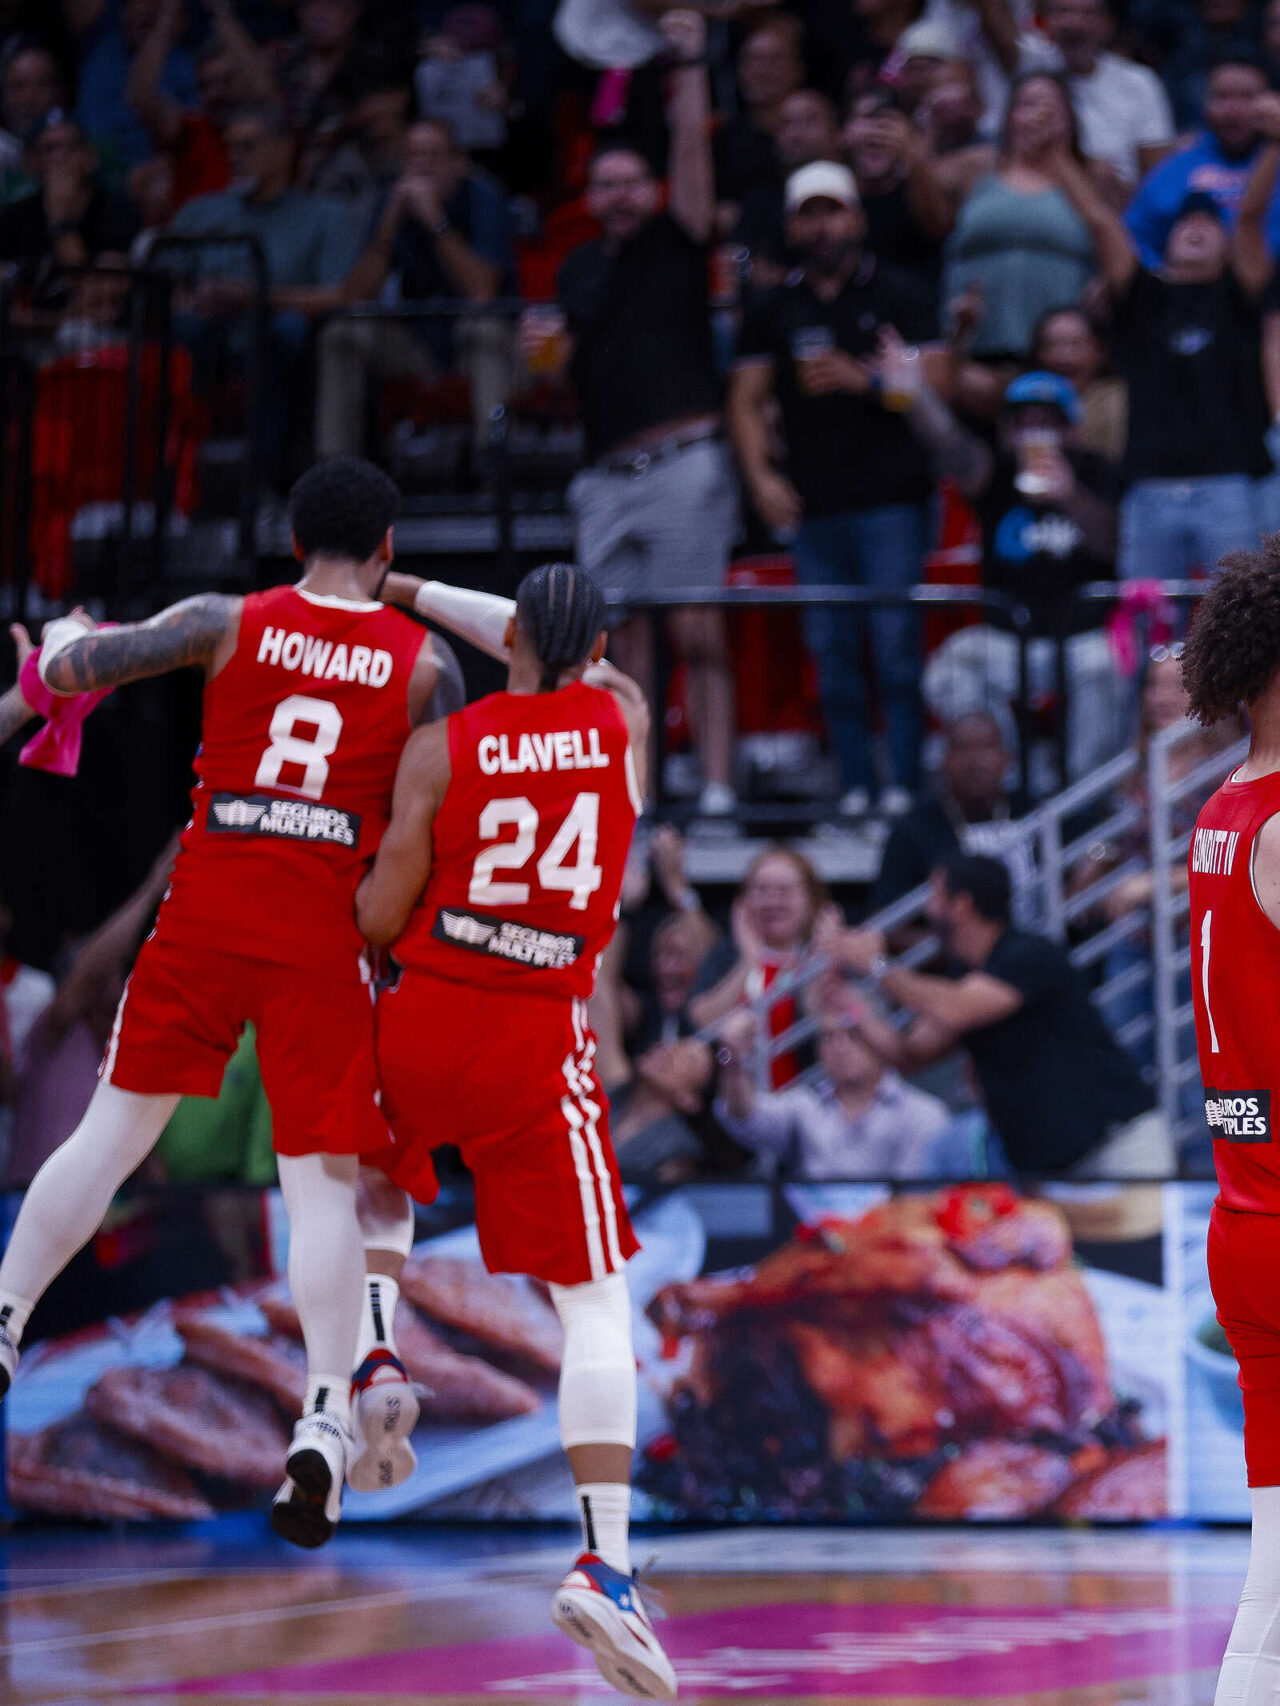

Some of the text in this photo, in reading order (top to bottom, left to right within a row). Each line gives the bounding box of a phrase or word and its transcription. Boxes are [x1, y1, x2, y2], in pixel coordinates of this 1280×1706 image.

[256, 627, 394, 688] HOWARD
[254, 694, 343, 800] 8
[477, 728, 610, 776] CLAVELL
[259, 814, 355, 846] MULTIPLES
[269, 800, 350, 829] SEGUROS
[468, 791, 602, 910] 24
[1200, 909, 1220, 1054] 1
